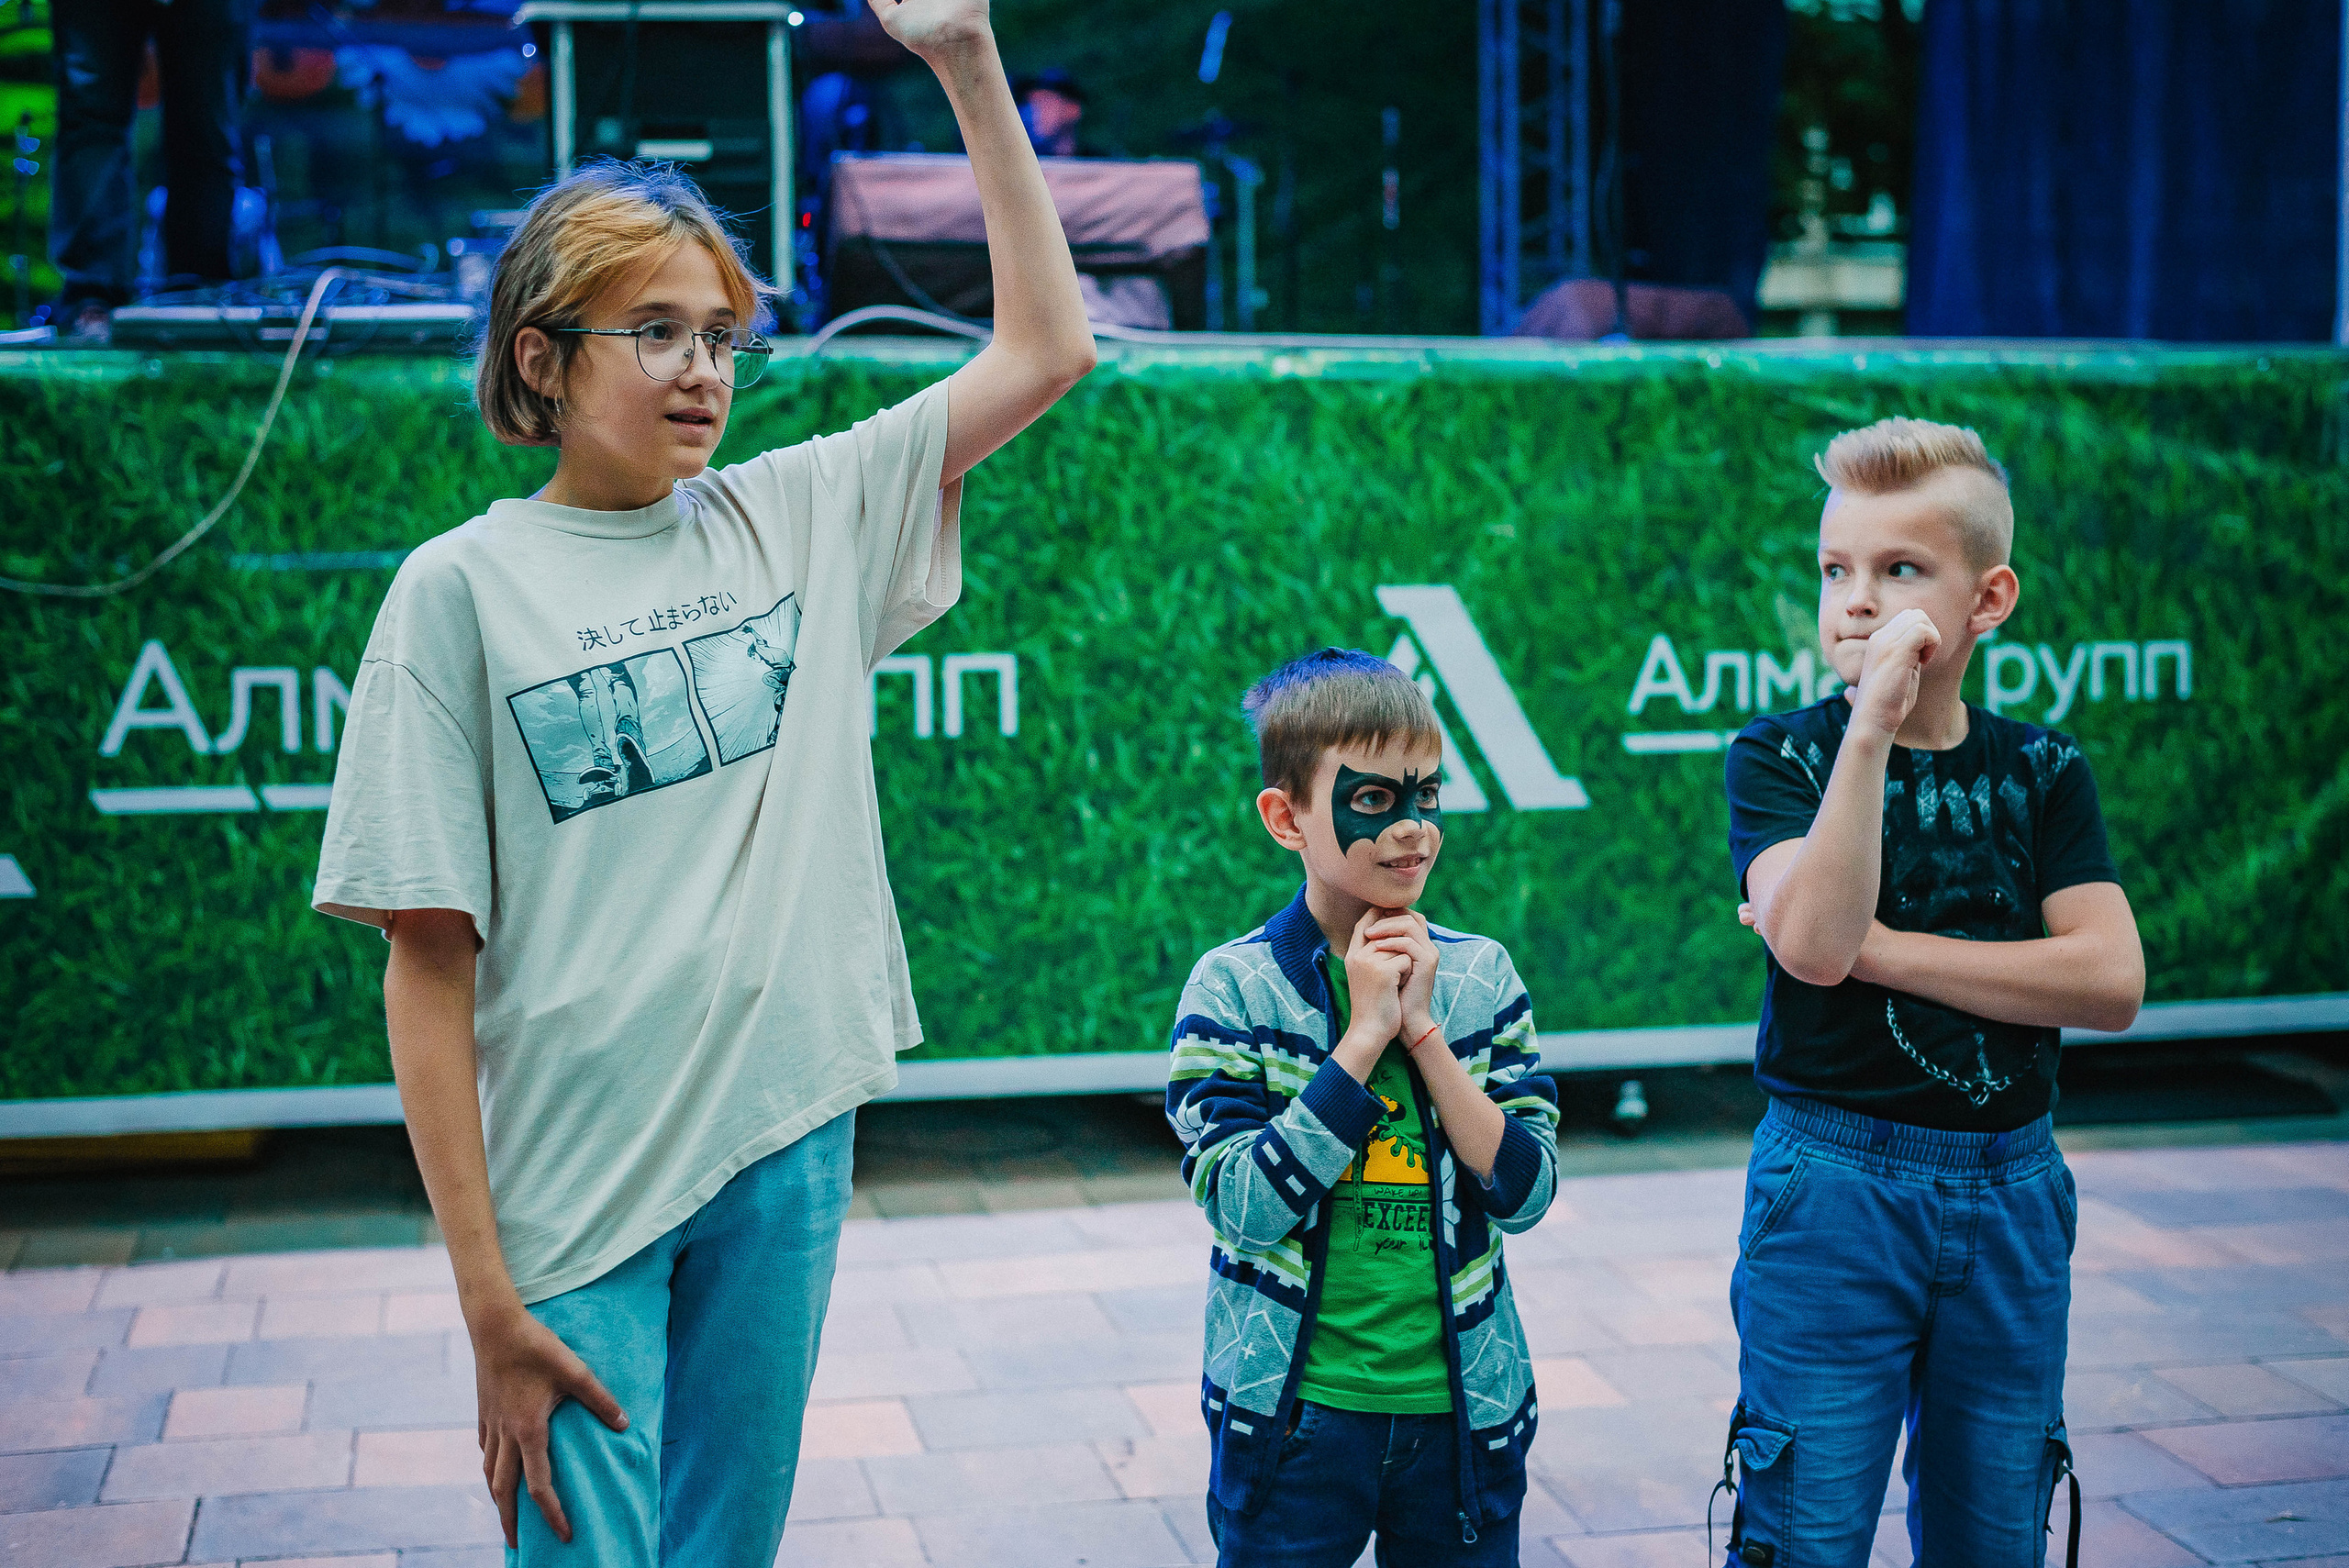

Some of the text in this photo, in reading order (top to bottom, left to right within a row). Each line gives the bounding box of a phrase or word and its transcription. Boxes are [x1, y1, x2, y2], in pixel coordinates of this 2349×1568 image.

[576, 591, 738, 651] 決して止まらない
[99, 639, 351, 757] Ал
[1977, 628, 2191, 724] рупп
[1374, 1187, 1404, 1196] WAKE
[1364, 1201, 1430, 1231] EXCEE
[1375, 1237, 1407, 1256] your
